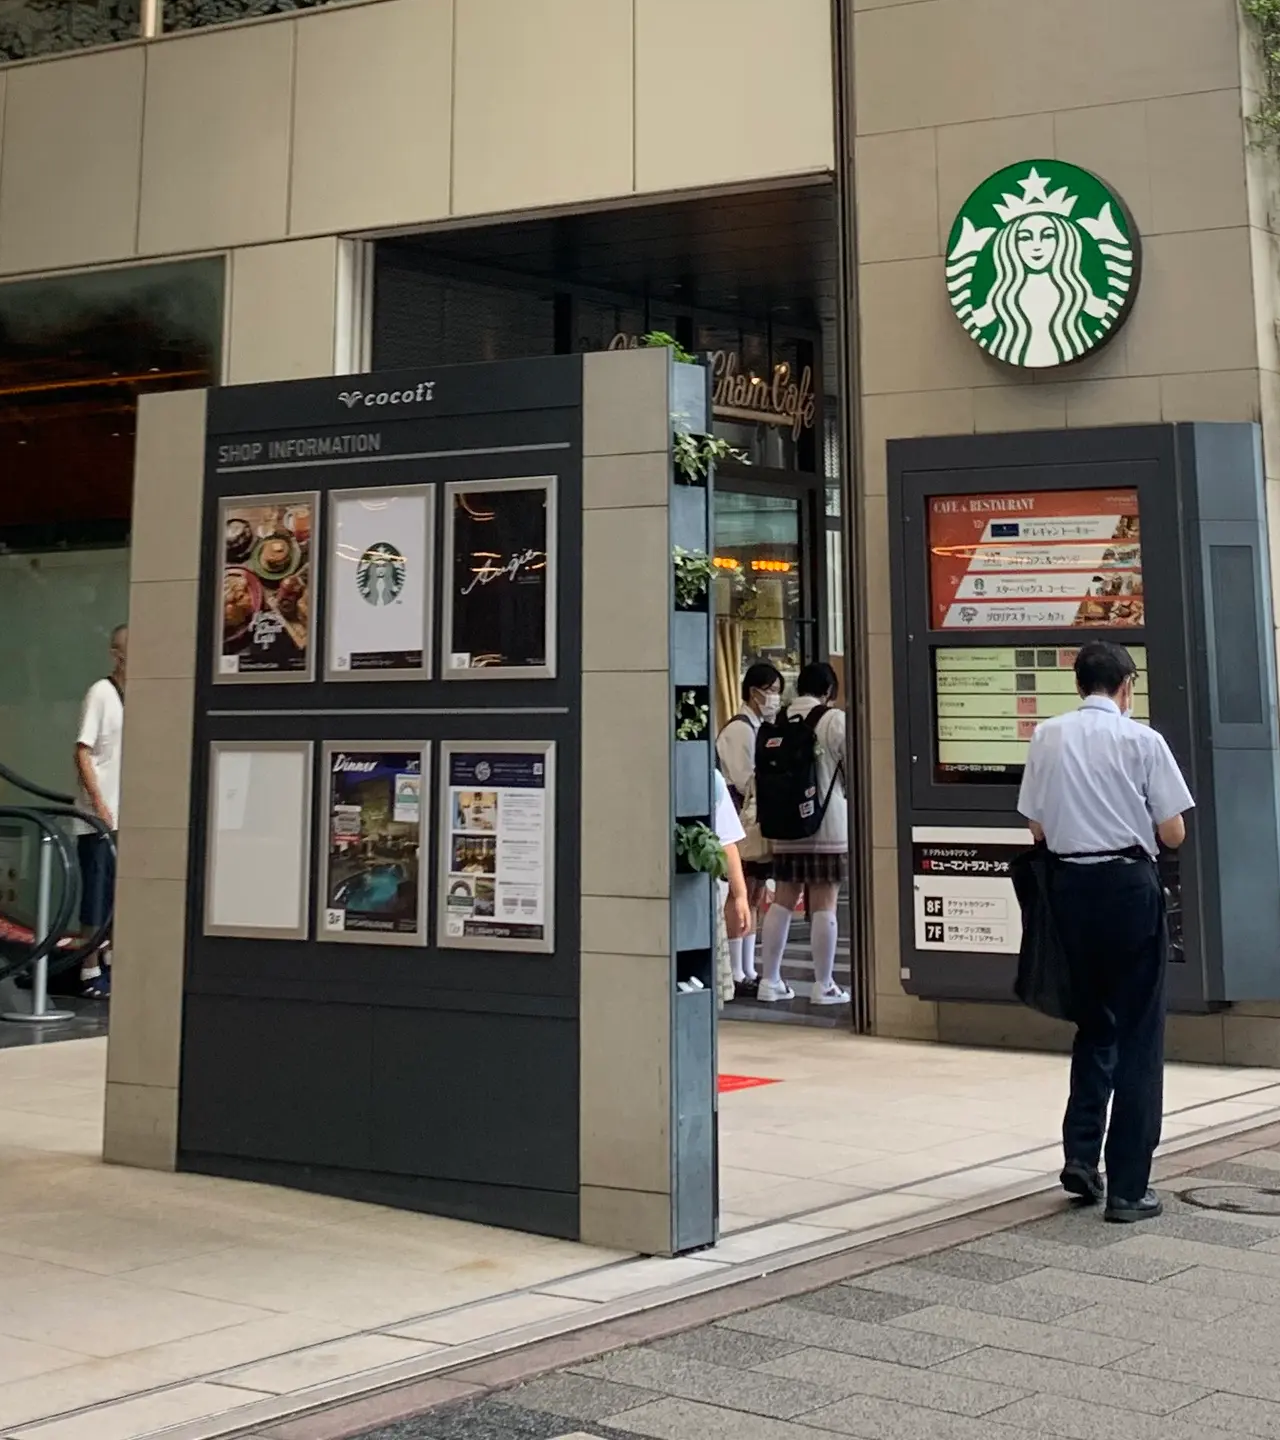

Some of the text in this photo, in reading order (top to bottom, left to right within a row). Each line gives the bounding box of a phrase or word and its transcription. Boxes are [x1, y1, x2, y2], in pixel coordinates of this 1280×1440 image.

[363, 381, 436, 407] cocoti
[218, 433, 381, 463] SHOP INFORMATION
[933, 500, 959, 514] CAFE
[969, 497, 1035, 513] RESTAURANT
[333, 753, 378, 773] Dinner
[931, 860, 993, 872] ヒューマントラスト
[926, 899, 942, 914] 8F
[328, 912, 341, 925] 3F
[927, 925, 942, 939] 7F
